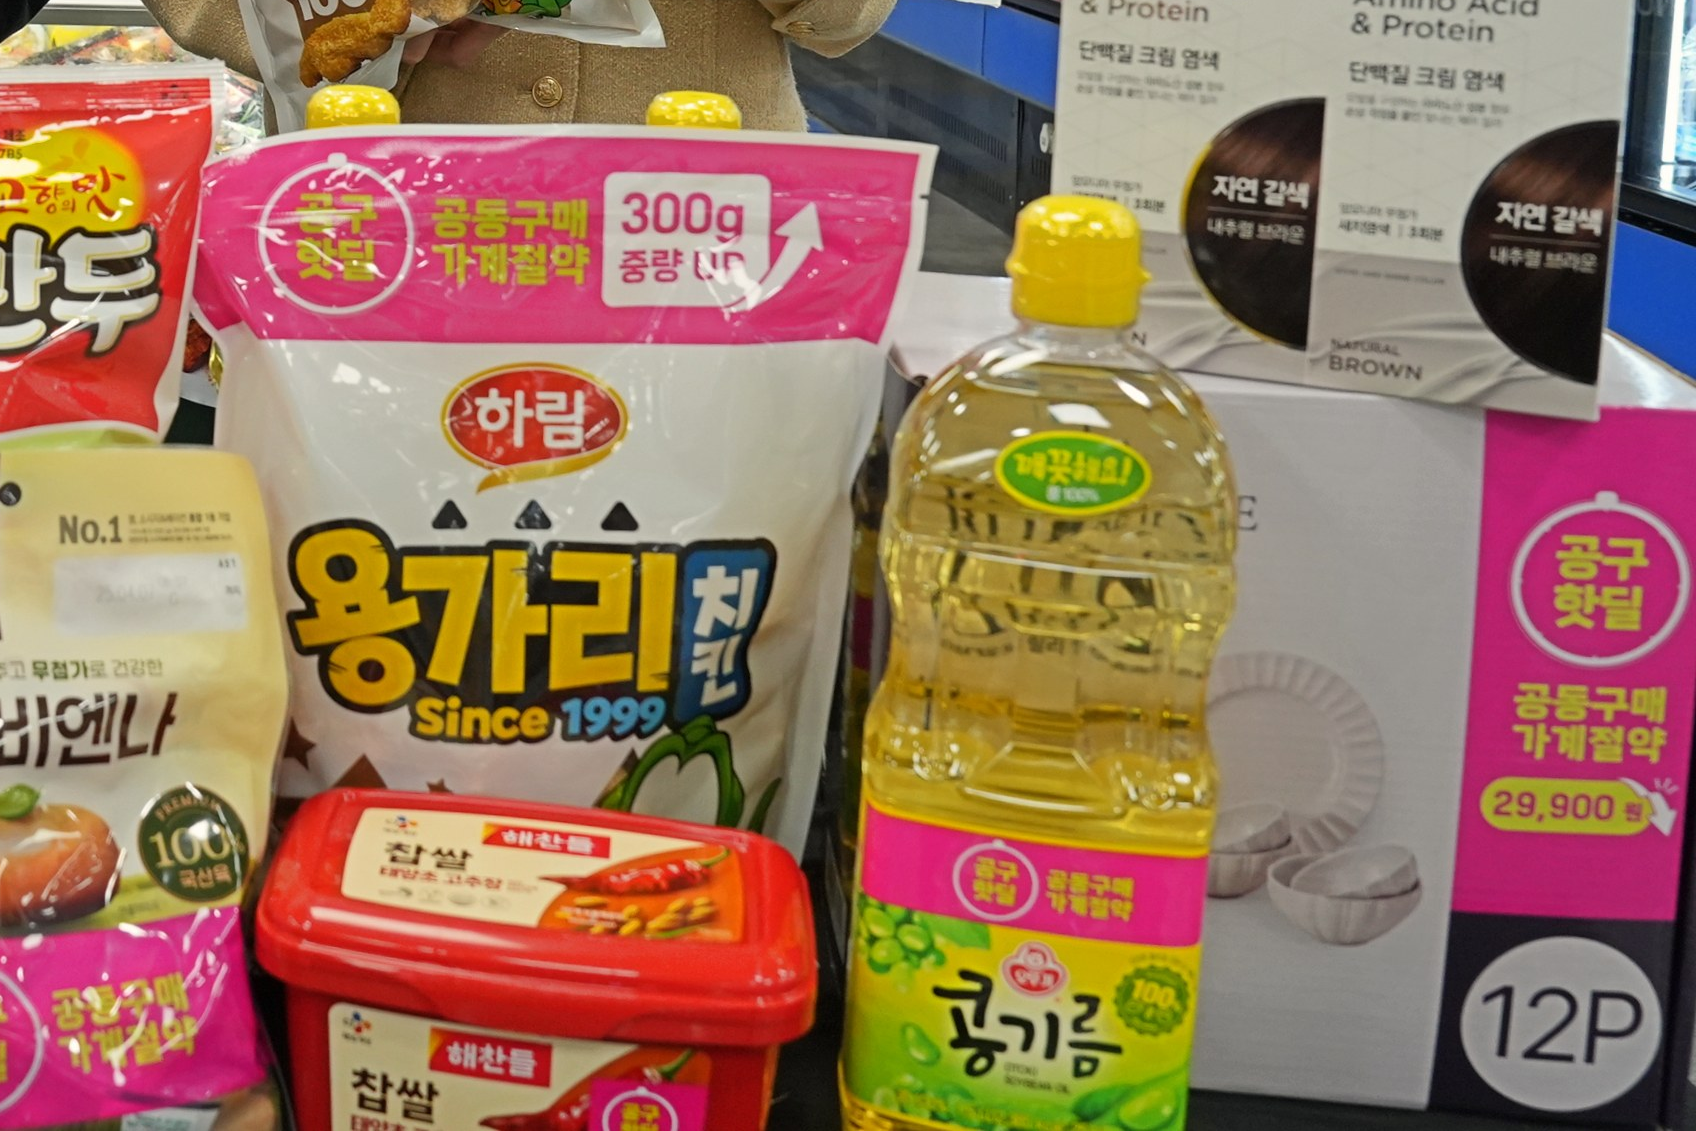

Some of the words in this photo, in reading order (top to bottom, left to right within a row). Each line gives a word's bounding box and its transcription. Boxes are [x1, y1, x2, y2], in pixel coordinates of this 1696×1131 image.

[1350, 11, 1371, 36] &
[1382, 14, 1495, 44] Protein
[1136, 44, 1176, 69] 크림
[1414, 66, 1457, 90] 크림
[294, 193, 379, 235] 공구
[431, 197, 589, 241] 공동구매
[619, 191, 745, 243] 300g
[294, 239, 377, 284] 핫딜
[431, 242, 591, 288] 가계절약
[617, 247, 683, 285] 중량
[1329, 355, 1423, 381] BROWN
[475, 388, 588, 451] 하림
[58, 514, 123, 546] No.1
[1555, 534, 1651, 581] 공구
[293, 523, 680, 709] 용가리
[1553, 585, 1644, 632] 핫딜
[691, 563, 753, 709] 치킨
[415, 697, 552, 741] Since
[562, 695, 667, 739] 1999
[1513, 681, 1668, 724] 공동구매
[1512, 723, 1668, 764] 가계절약
[1492, 789, 1616, 826] 29,900
[500, 827, 596, 856] 해찬들
[973, 855, 1020, 882] 공구
[931, 968, 1124, 1079] 콩기름
[1478, 983, 1645, 1066] 12P
[350, 1068, 440, 1125] 찹쌀
